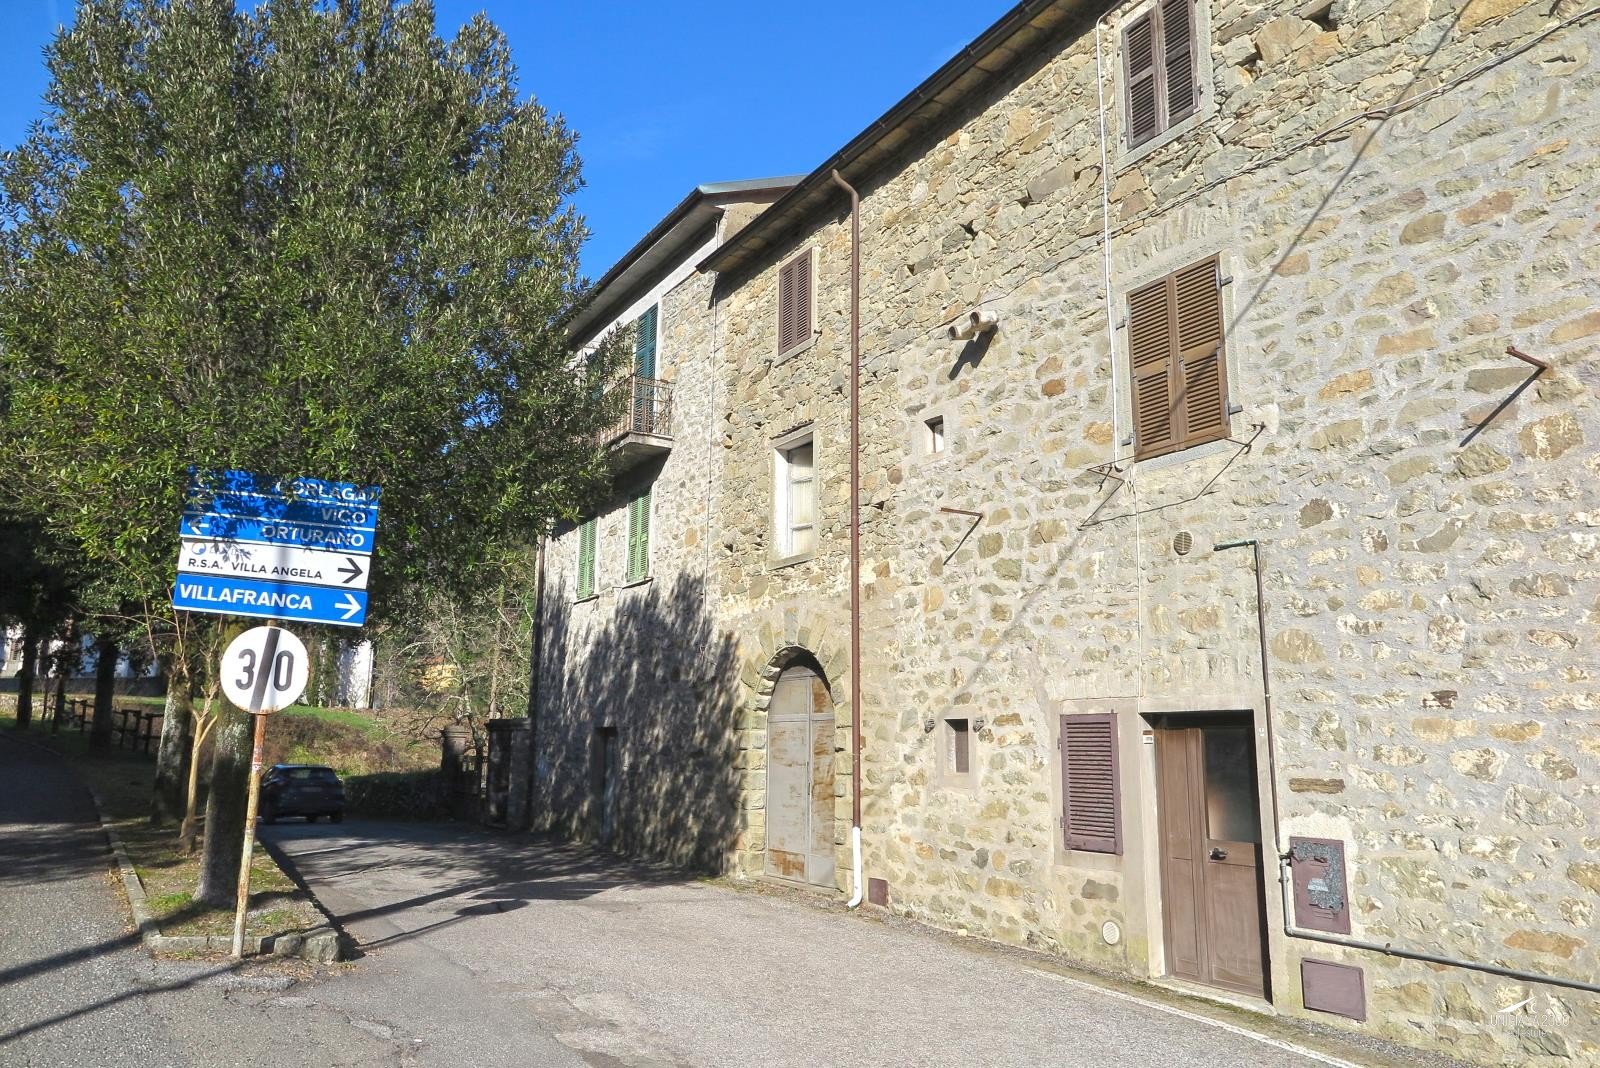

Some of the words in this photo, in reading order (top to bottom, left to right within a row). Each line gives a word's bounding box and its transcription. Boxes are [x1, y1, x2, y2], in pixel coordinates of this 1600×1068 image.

[321, 507, 366, 524] VICO
[262, 525, 365, 547] ORTURANO
[188, 558, 223, 570] R.S.A.
[231, 562, 267, 574] VILLA
[271, 566, 322, 579] ANGELA
[179, 584, 312, 610] VILLAFRANCA
[235, 648, 294, 692] 30
